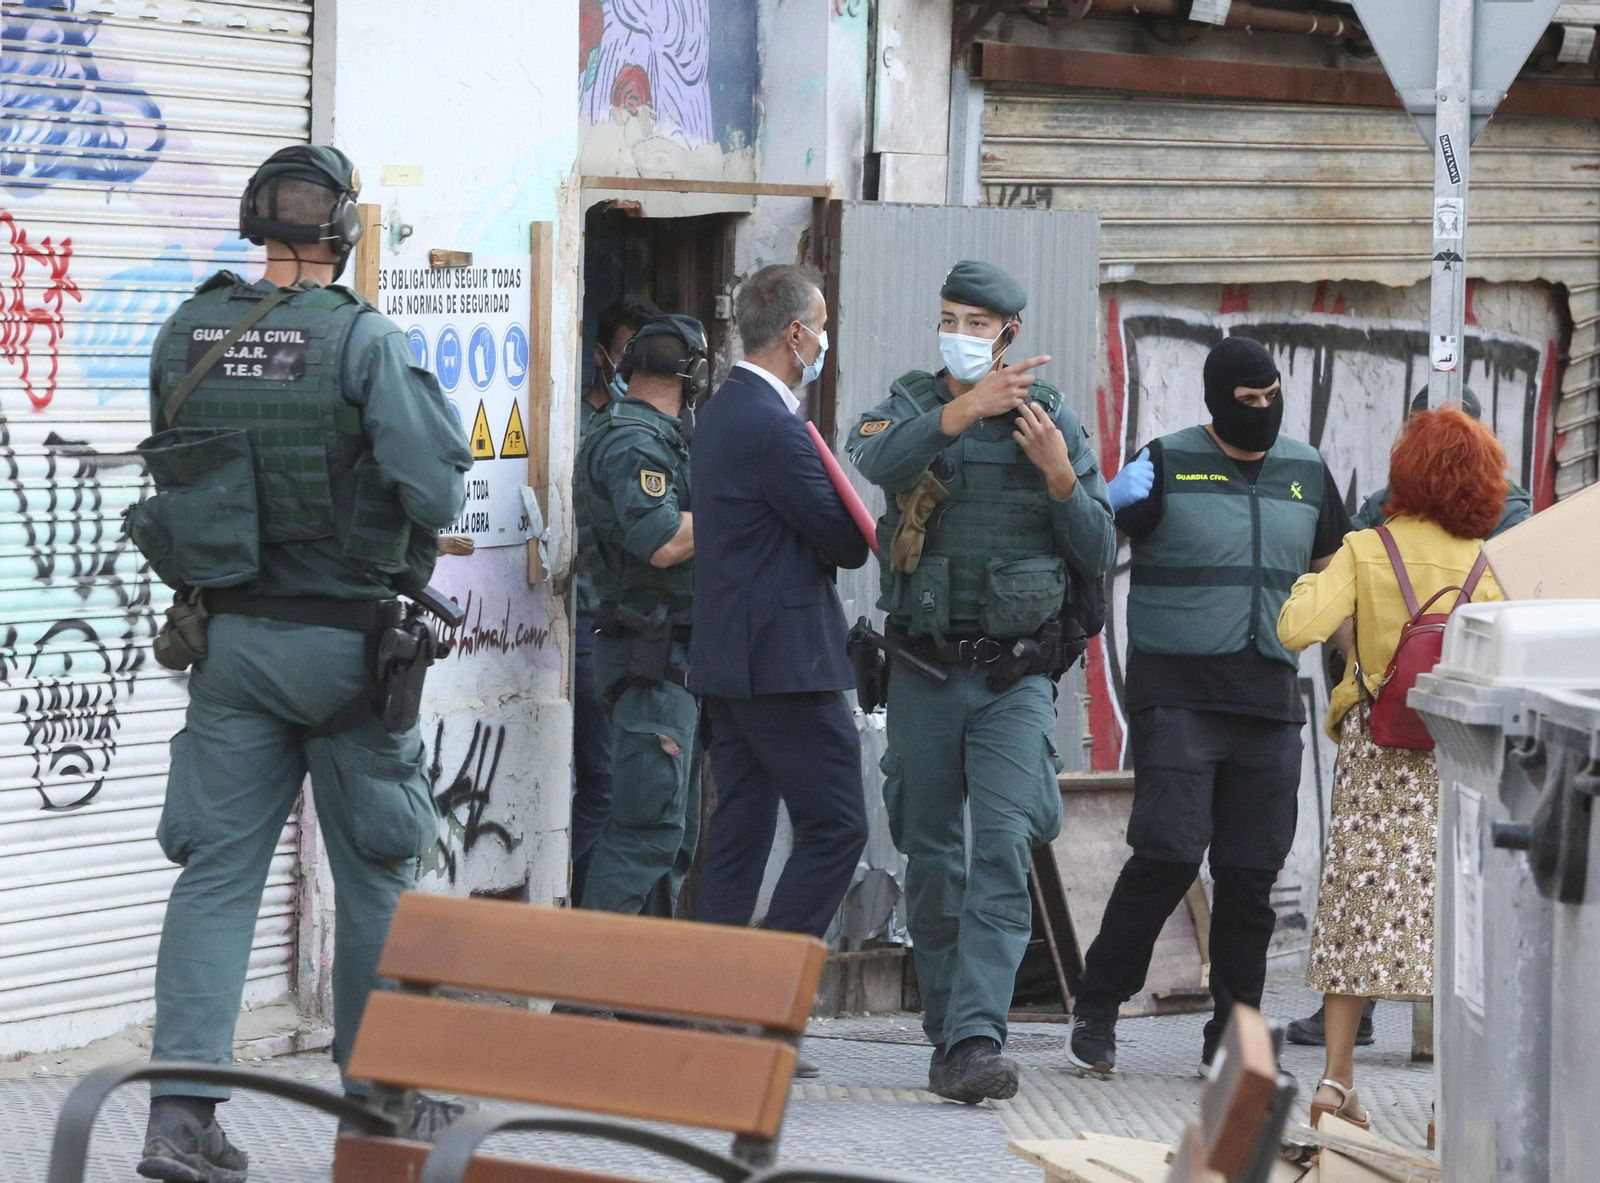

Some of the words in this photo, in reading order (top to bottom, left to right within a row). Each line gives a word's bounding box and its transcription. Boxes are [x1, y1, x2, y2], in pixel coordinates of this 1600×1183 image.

[391, 268, 451, 290] OBLIGATORIO
[454, 268, 488, 289] SEGUIR
[492, 268, 522, 289] TODAS
[386, 295, 403, 315] LAS
[406, 295, 443, 315] NORMAS
[446, 294, 457, 314] DE
[459, 294, 510, 314] SEGURIDAD
[192, 328, 261, 343] GUAIA
[263, 330, 305, 344] CIVIL
[1176, 473, 1208, 481] GUARDIA
[1209, 474, 1229, 482] CIVIL
[473, 479, 489, 500] TODA
[460, 513, 470, 534] LA
[471, 511, 490, 533] OBRA
